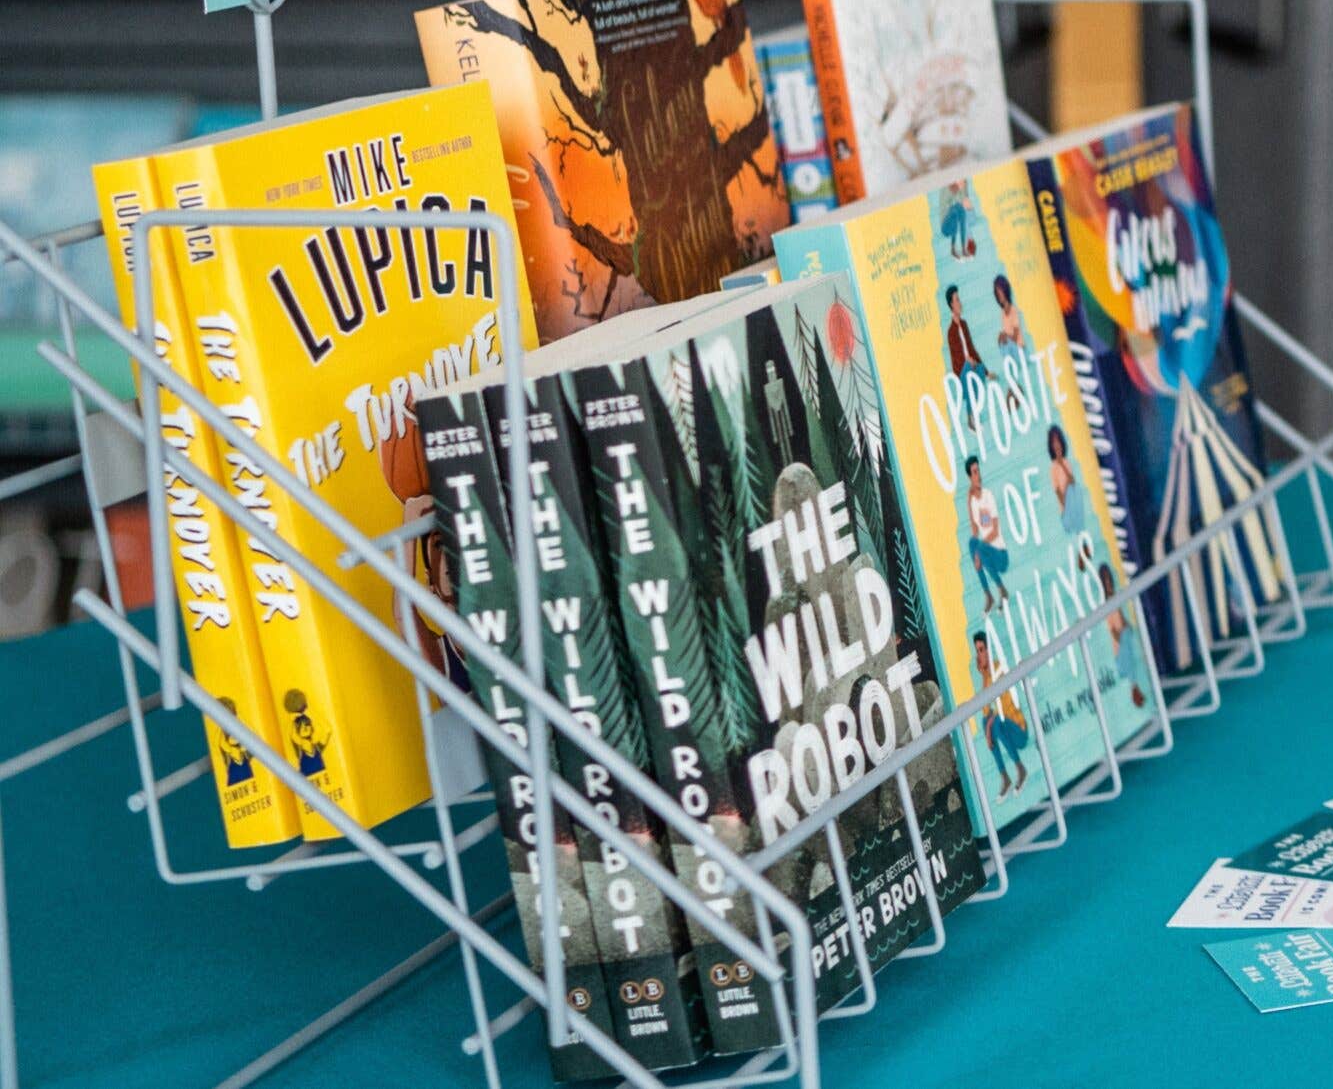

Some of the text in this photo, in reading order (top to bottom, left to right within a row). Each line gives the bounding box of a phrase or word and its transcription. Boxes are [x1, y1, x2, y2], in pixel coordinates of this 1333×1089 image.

[455, 38, 480, 82] KEL
[175, 183, 215, 263] LUICA
[326, 134, 411, 206] MIKE
[268, 194, 495, 367] LUPICA
[288, 311, 503, 488] THE TURNOVE
[425, 425, 479, 446] PETER
[425, 440, 484, 462] BROWN
[499, 412, 553, 433] PER
[499, 426, 558, 450] BWN
[585, 394, 641, 416] PETER
[585, 408, 645, 432] BROWN
[917, 341, 1068, 494] OPPOSITE
[219, 395, 300, 624] TRNVER
[446, 472, 493, 585] THE
[528, 460, 566, 572] THE
[747, 480, 858, 597] THE
[1001, 465, 1043, 549] OF
[467, 609, 529, 749] WLD
[607, 442, 735, 921] THE WILD ROOT
[744, 566, 895, 723] WILD
[984, 531, 1108, 722] ALWAYS
[748, 649, 924, 847] ROBOT
